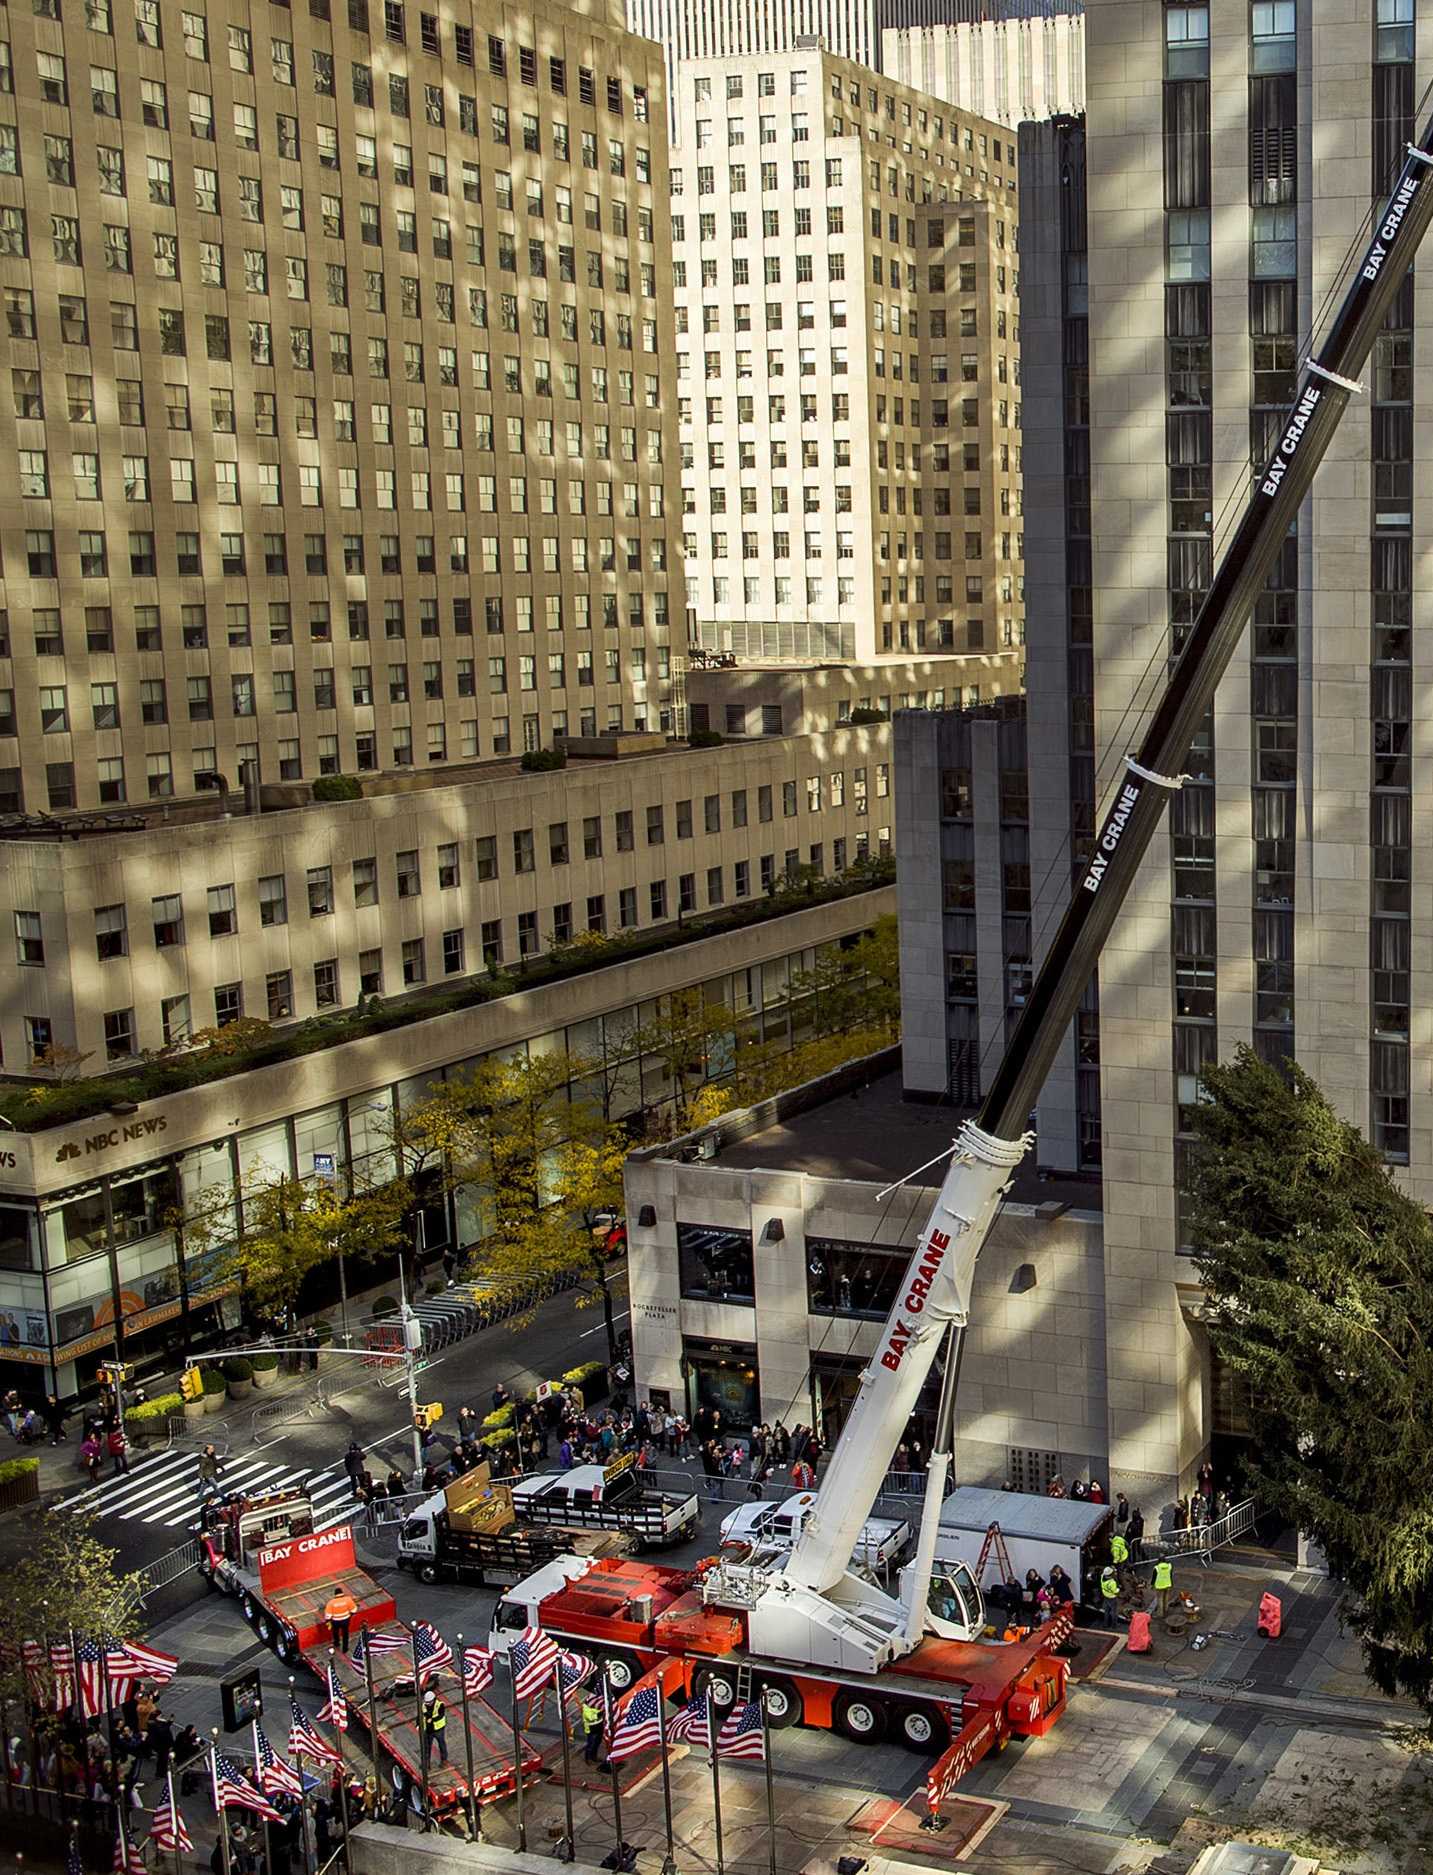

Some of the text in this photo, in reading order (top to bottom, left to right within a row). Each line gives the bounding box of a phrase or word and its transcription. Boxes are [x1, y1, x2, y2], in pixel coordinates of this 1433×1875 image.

[1363, 177, 1419, 281] BAY CRANE
[1262, 385, 1321, 497] BAY CRANE
[1083, 784, 1140, 892] BAY CRANE
[85, 1115, 168, 1154] NBC NEWS
[632, 1304, 677, 1313] ROCKEFELLER
[645, 1311, 665, 1320] PLAZA
[881, 1228, 951, 1372] BAY CRANE
[264, 1530, 348, 1564] BAY CRANE
